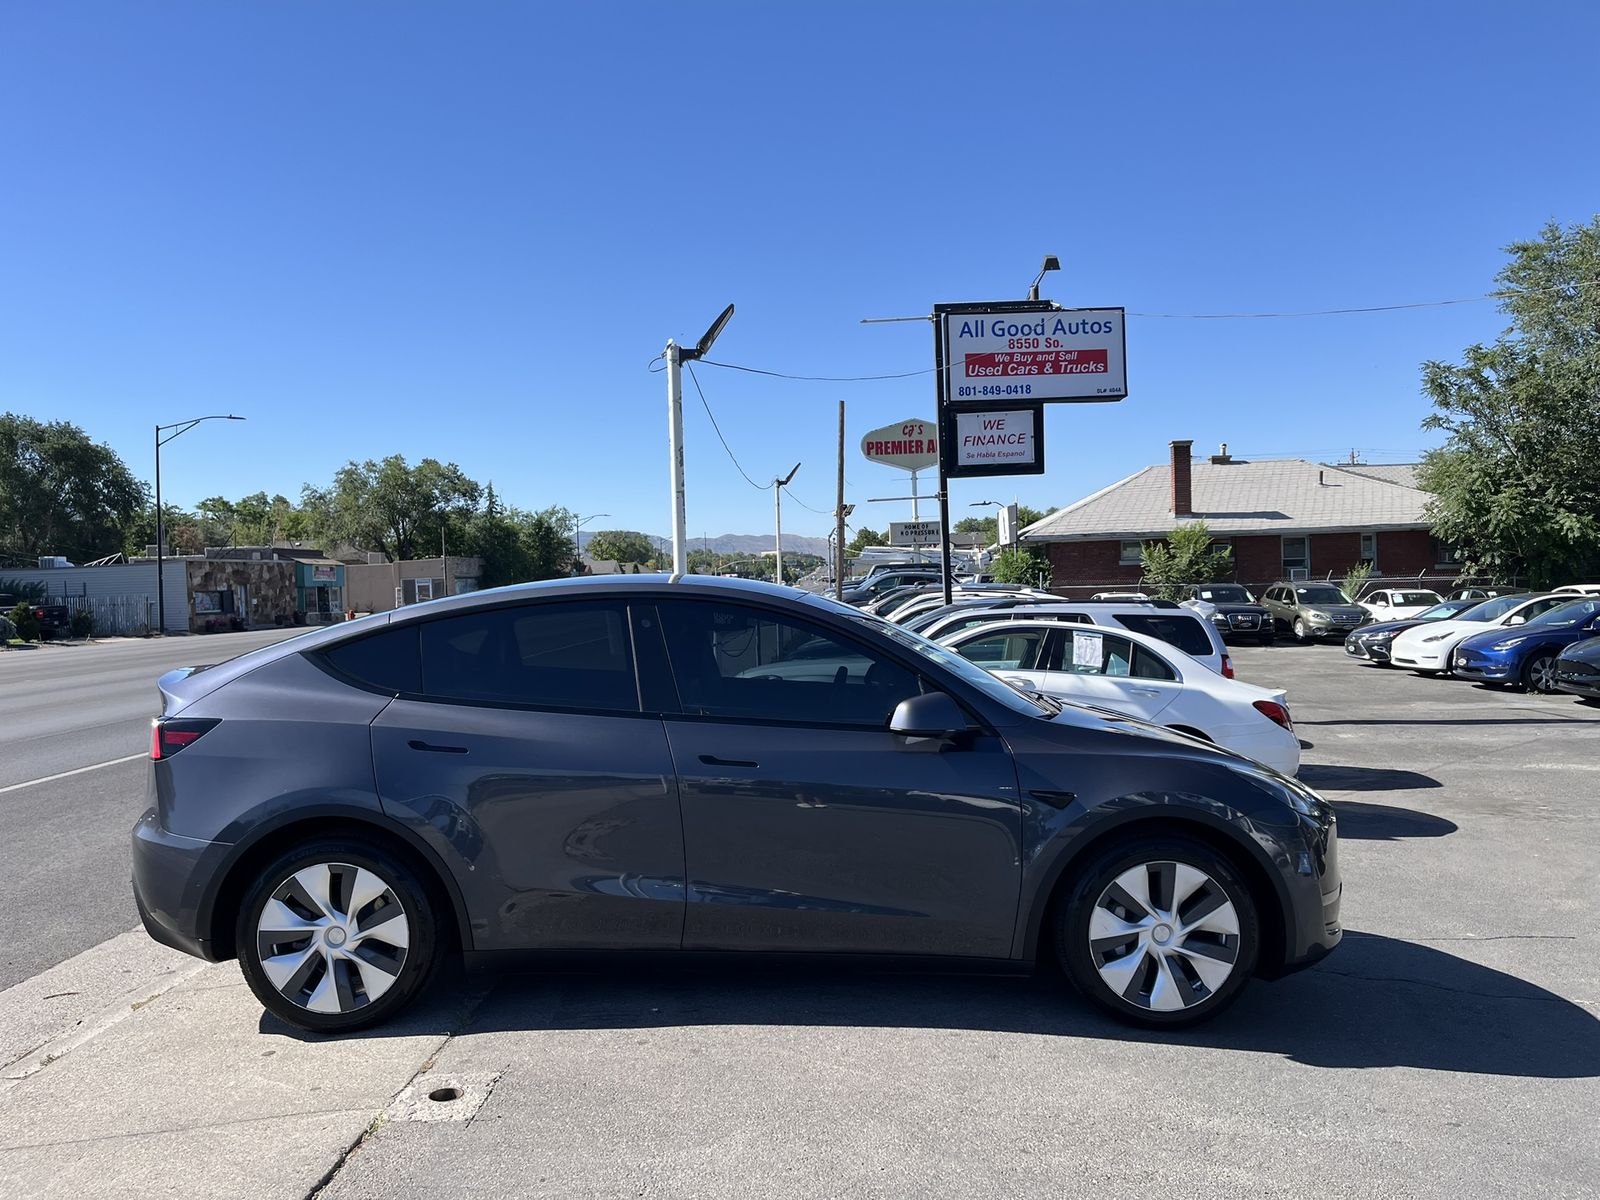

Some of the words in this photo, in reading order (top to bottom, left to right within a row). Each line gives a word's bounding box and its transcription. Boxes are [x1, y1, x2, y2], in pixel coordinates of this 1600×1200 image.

[959, 319, 984, 338] All
[991, 318, 1045, 337] Good
[1052, 318, 1112, 335] Autos
[1008, 338, 1039, 349] 8550
[1045, 338, 1063, 348] So.
[994, 354, 1010, 363] We
[1013, 353, 1033, 364] Buy
[1036, 352, 1055, 361] and
[1058, 351, 1077, 360] Sell
[968, 364, 1002, 376] Used
[1007, 363, 1039, 375] Cars
[1043, 363, 1054, 374] &
[1060, 361, 1105, 373] Trucks
[958, 384, 1032, 397] 801-849-0418
[983, 419, 1006, 431] WE
[963, 433, 1027, 447] FINANCE
[866, 440, 924, 456] PREMIER
[927, 439, 937, 453] A
[976, 451, 996, 459] Habla
[997, 450, 1025, 459] Espanol
